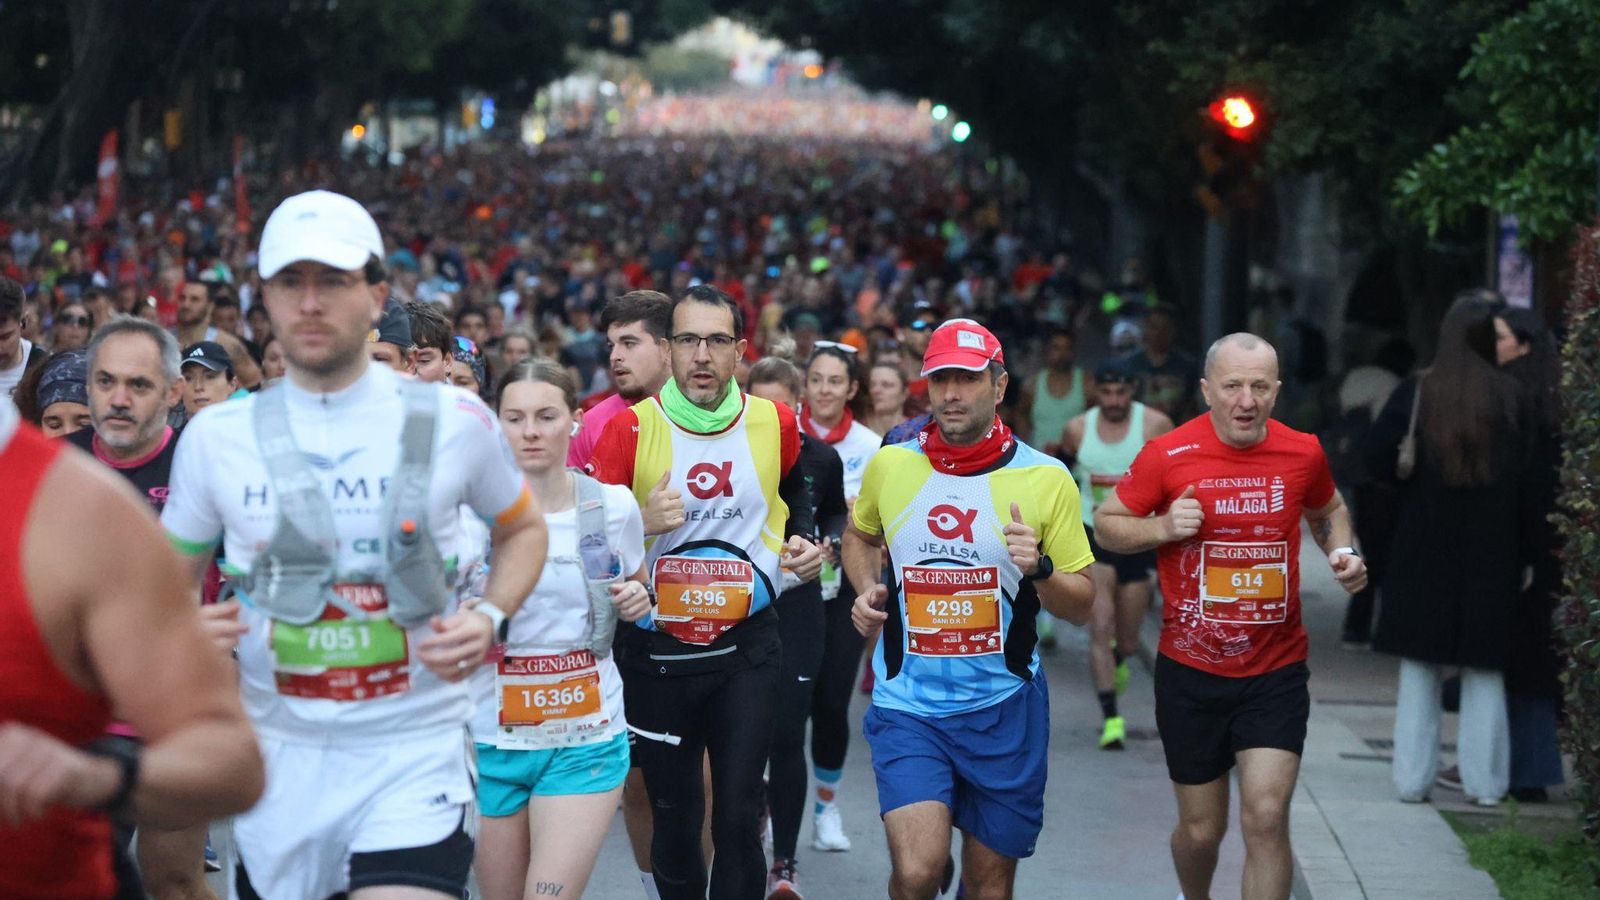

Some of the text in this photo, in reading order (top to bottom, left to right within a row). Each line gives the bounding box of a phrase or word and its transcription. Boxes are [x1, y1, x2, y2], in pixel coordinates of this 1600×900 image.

[1215, 477, 1266, 488] GENERALI
[1215, 496, 1268, 514] MÁLAGA
[685, 508, 744, 522] JEALSA
[918, 542, 981, 561] JEALSA
[1228, 547, 1282, 559] GENERALI
[682, 561, 746, 577] GENERALI
[1231, 572, 1264, 587] 614
[679, 589, 727, 607] 4396
[926, 600, 974, 616] 4298
[304, 626, 371, 650] 7051
[522, 685, 586, 708] 16366
[536, 881, 564, 896] 1997
